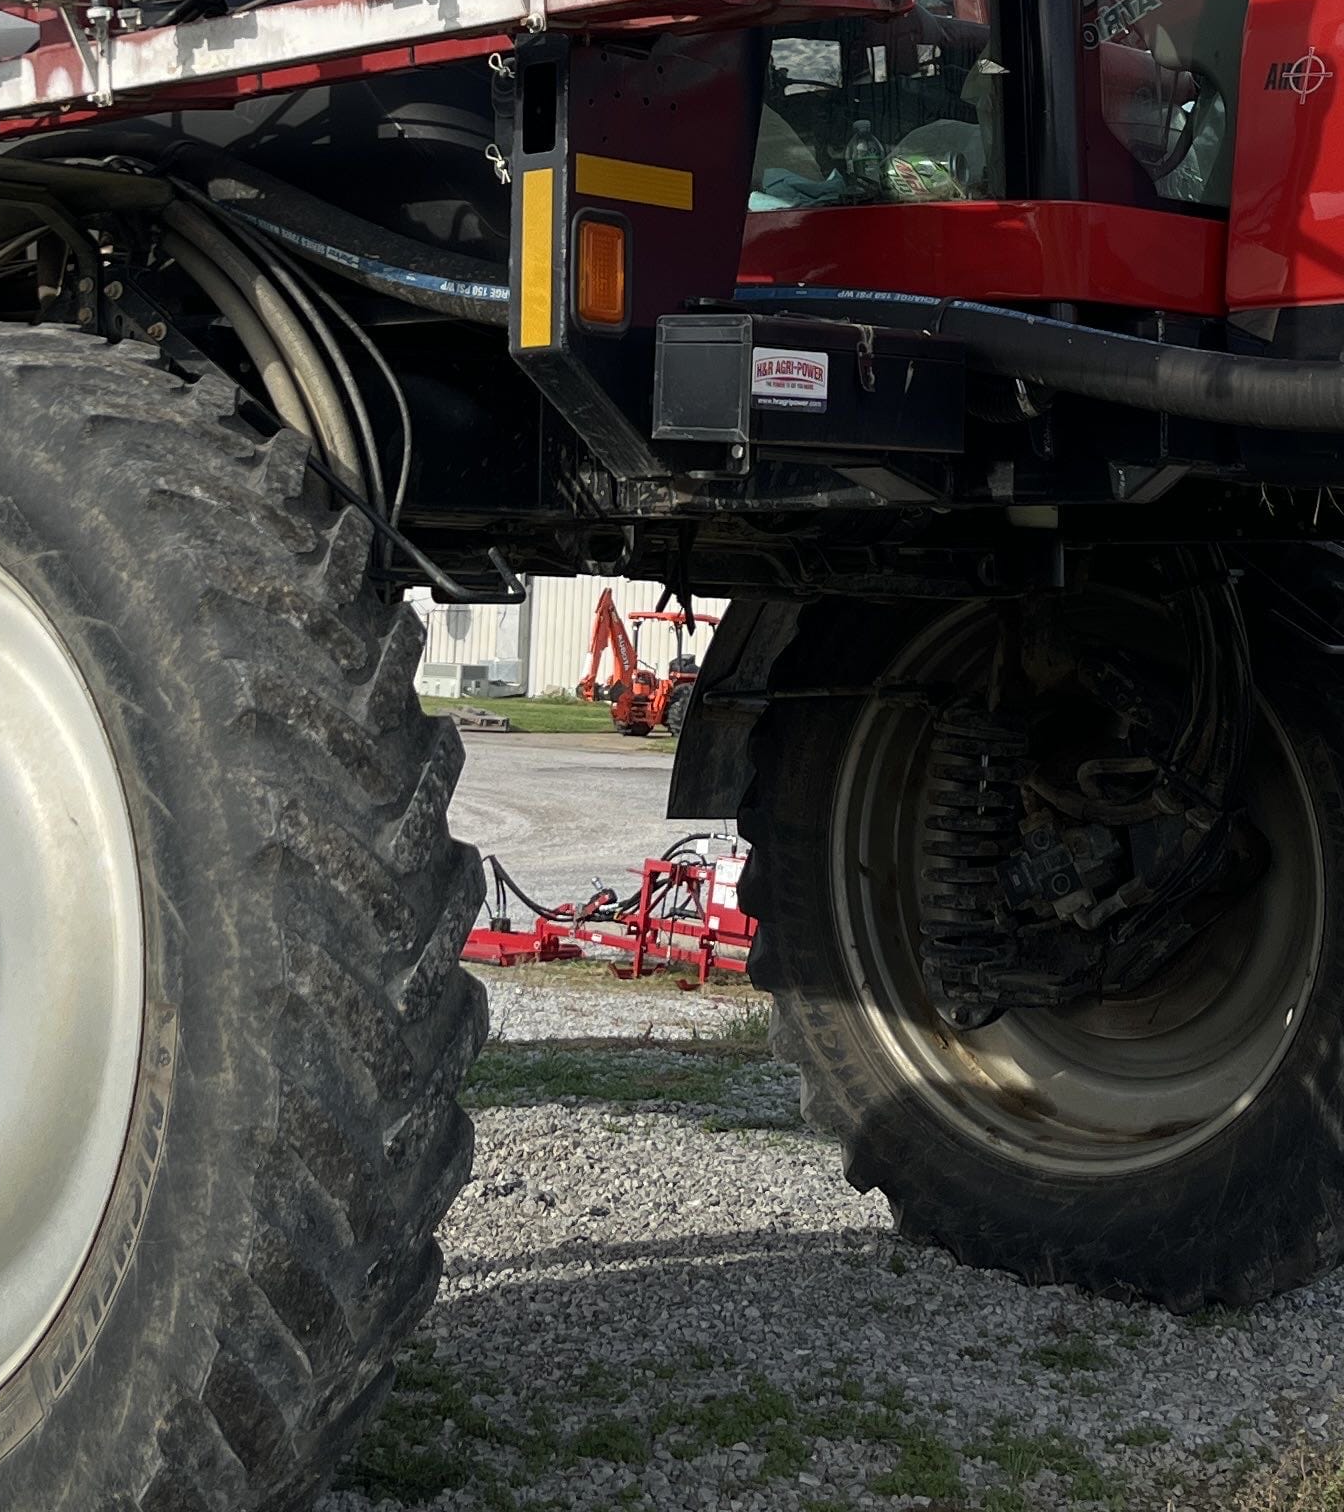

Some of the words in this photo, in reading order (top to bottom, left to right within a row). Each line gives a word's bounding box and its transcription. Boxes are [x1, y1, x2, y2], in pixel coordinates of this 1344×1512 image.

[457, 283, 472, 296] PSI
[756, 361, 774, 377] H&R
[775, 359, 825, 382] AGRI-POWER
[617, 631, 631, 672] KUBOTA
